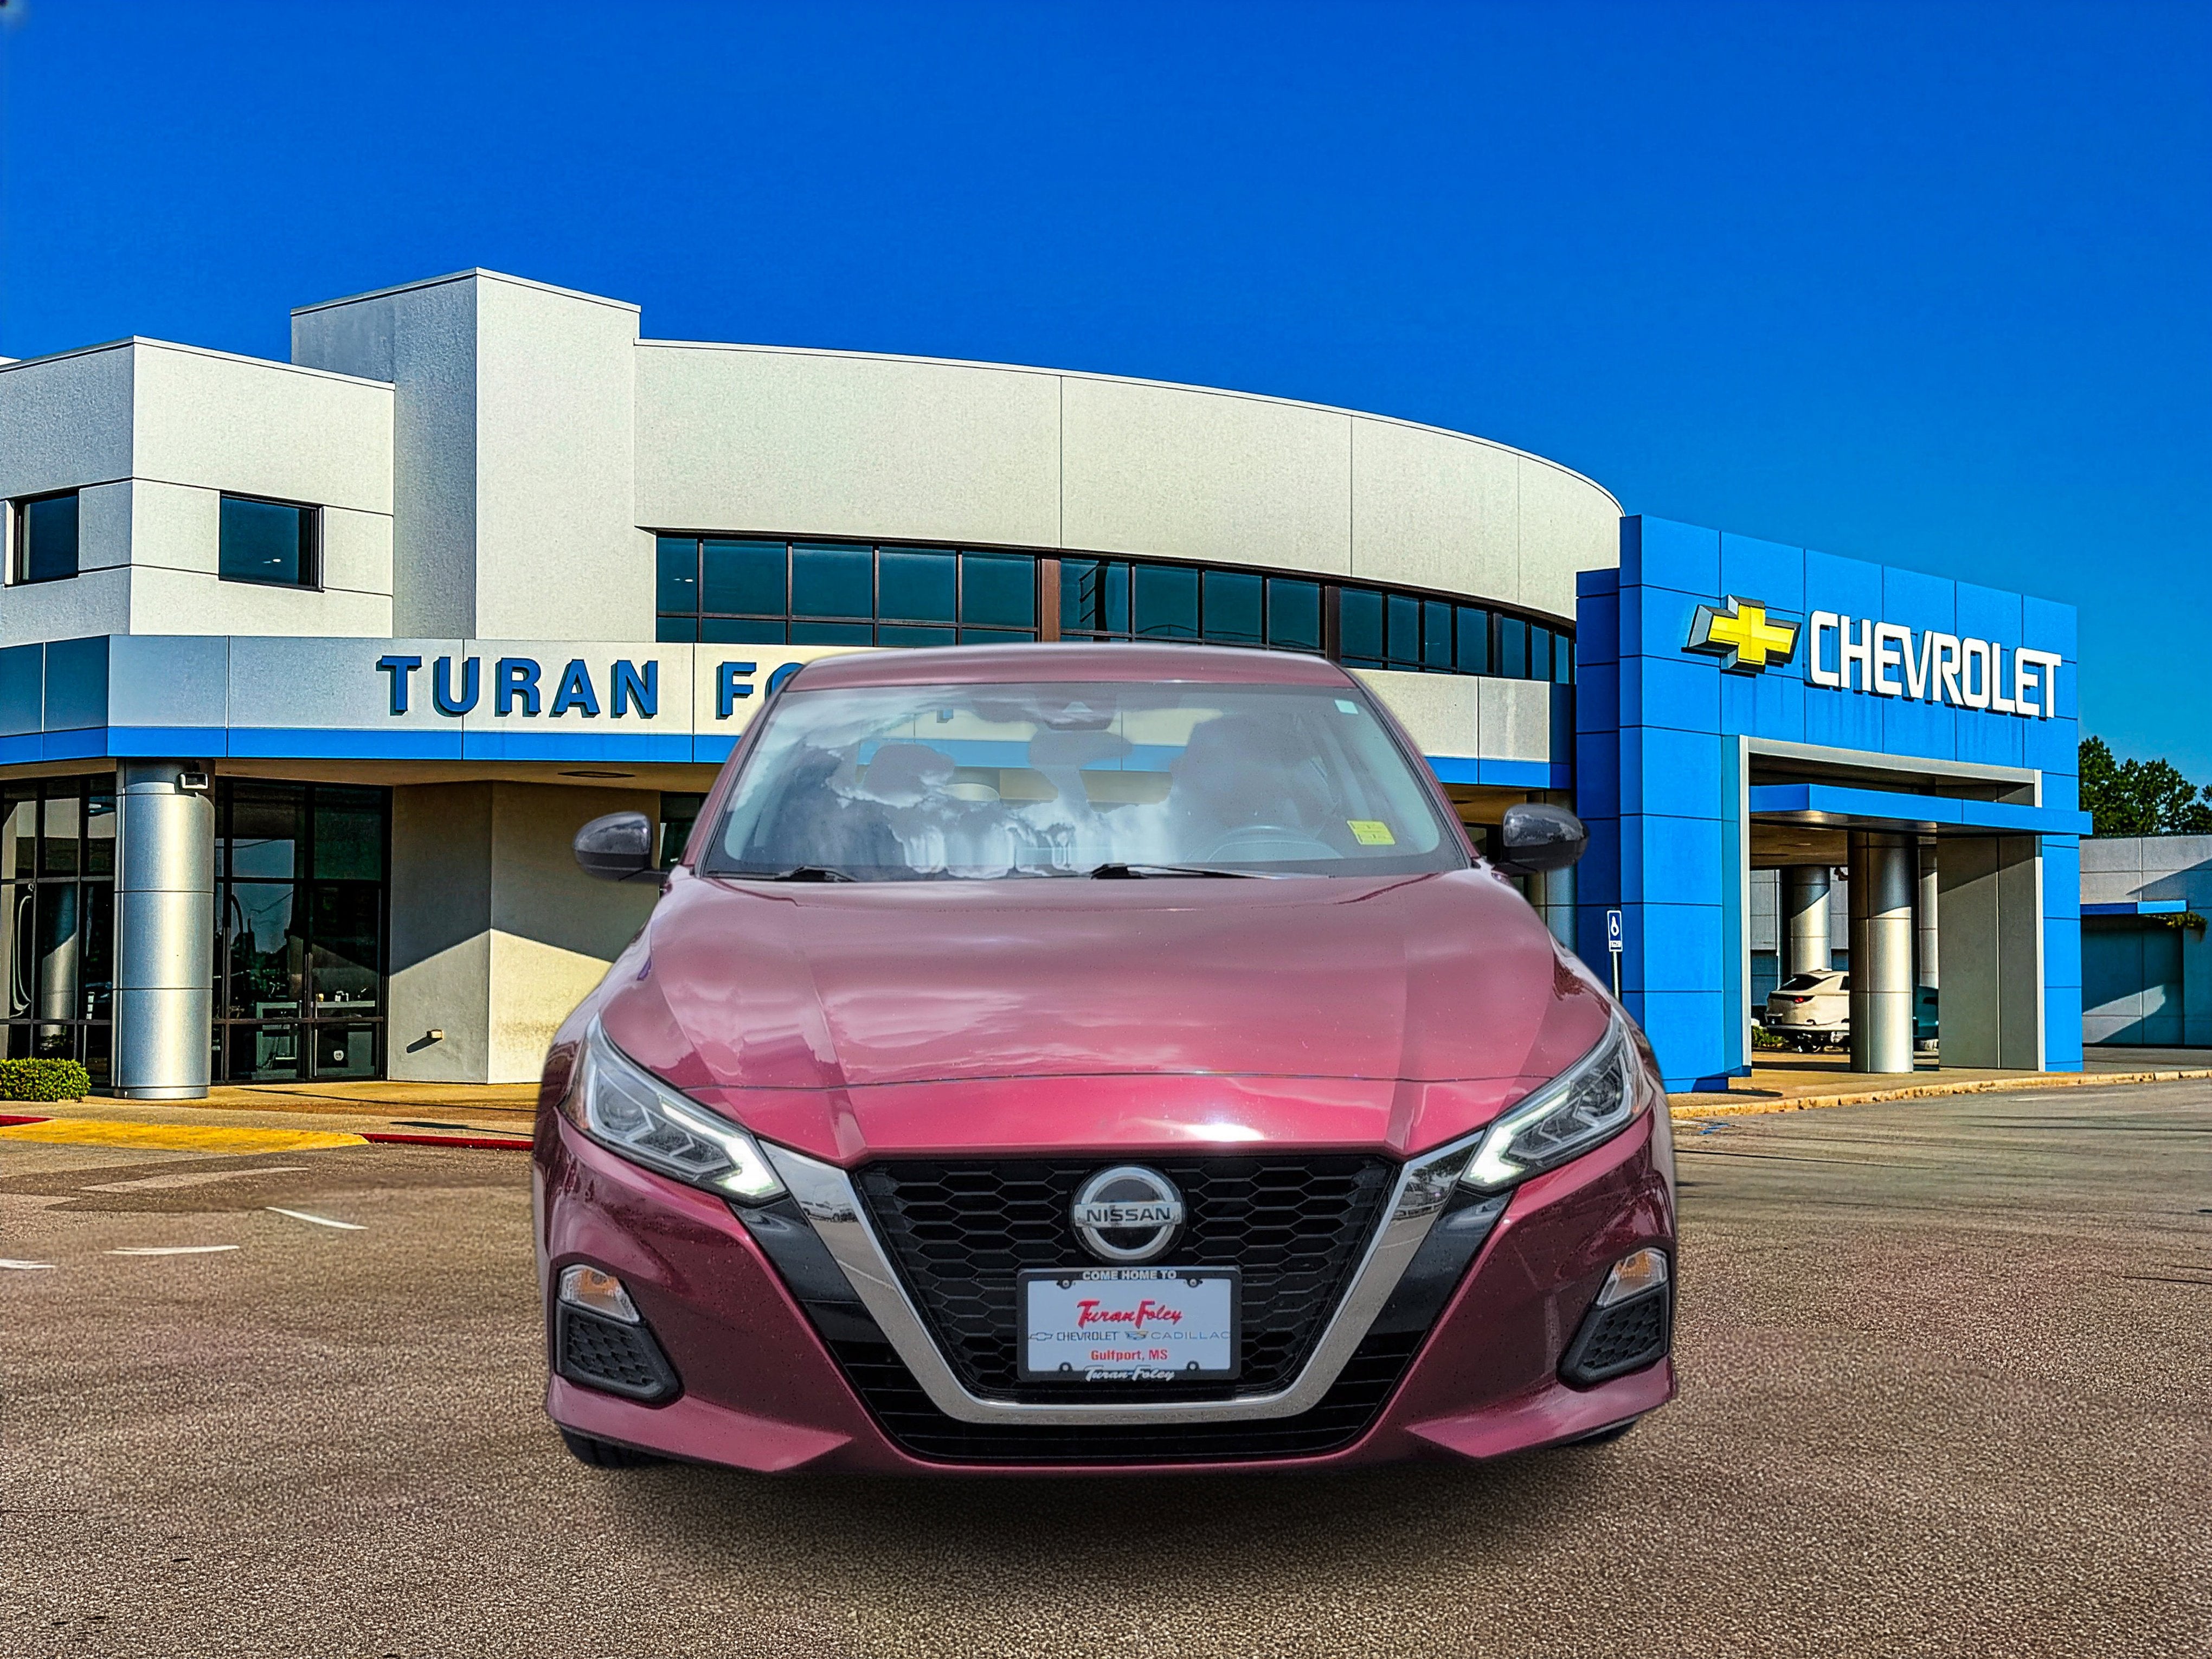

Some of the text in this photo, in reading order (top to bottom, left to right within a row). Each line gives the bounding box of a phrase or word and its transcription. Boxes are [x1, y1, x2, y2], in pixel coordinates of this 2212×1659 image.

[1810, 609, 2062, 719] CHEVROLET
[377, 655, 659, 718] TURAN
[1086, 1207, 1171, 1222] NISSAN
[1083, 1269, 1177, 1281] COME HOME TO
[1057, 1330, 1230, 1341] CHEVROLET CADILLAC
[1091, 1349, 1168, 1362] Gulfport, MS
